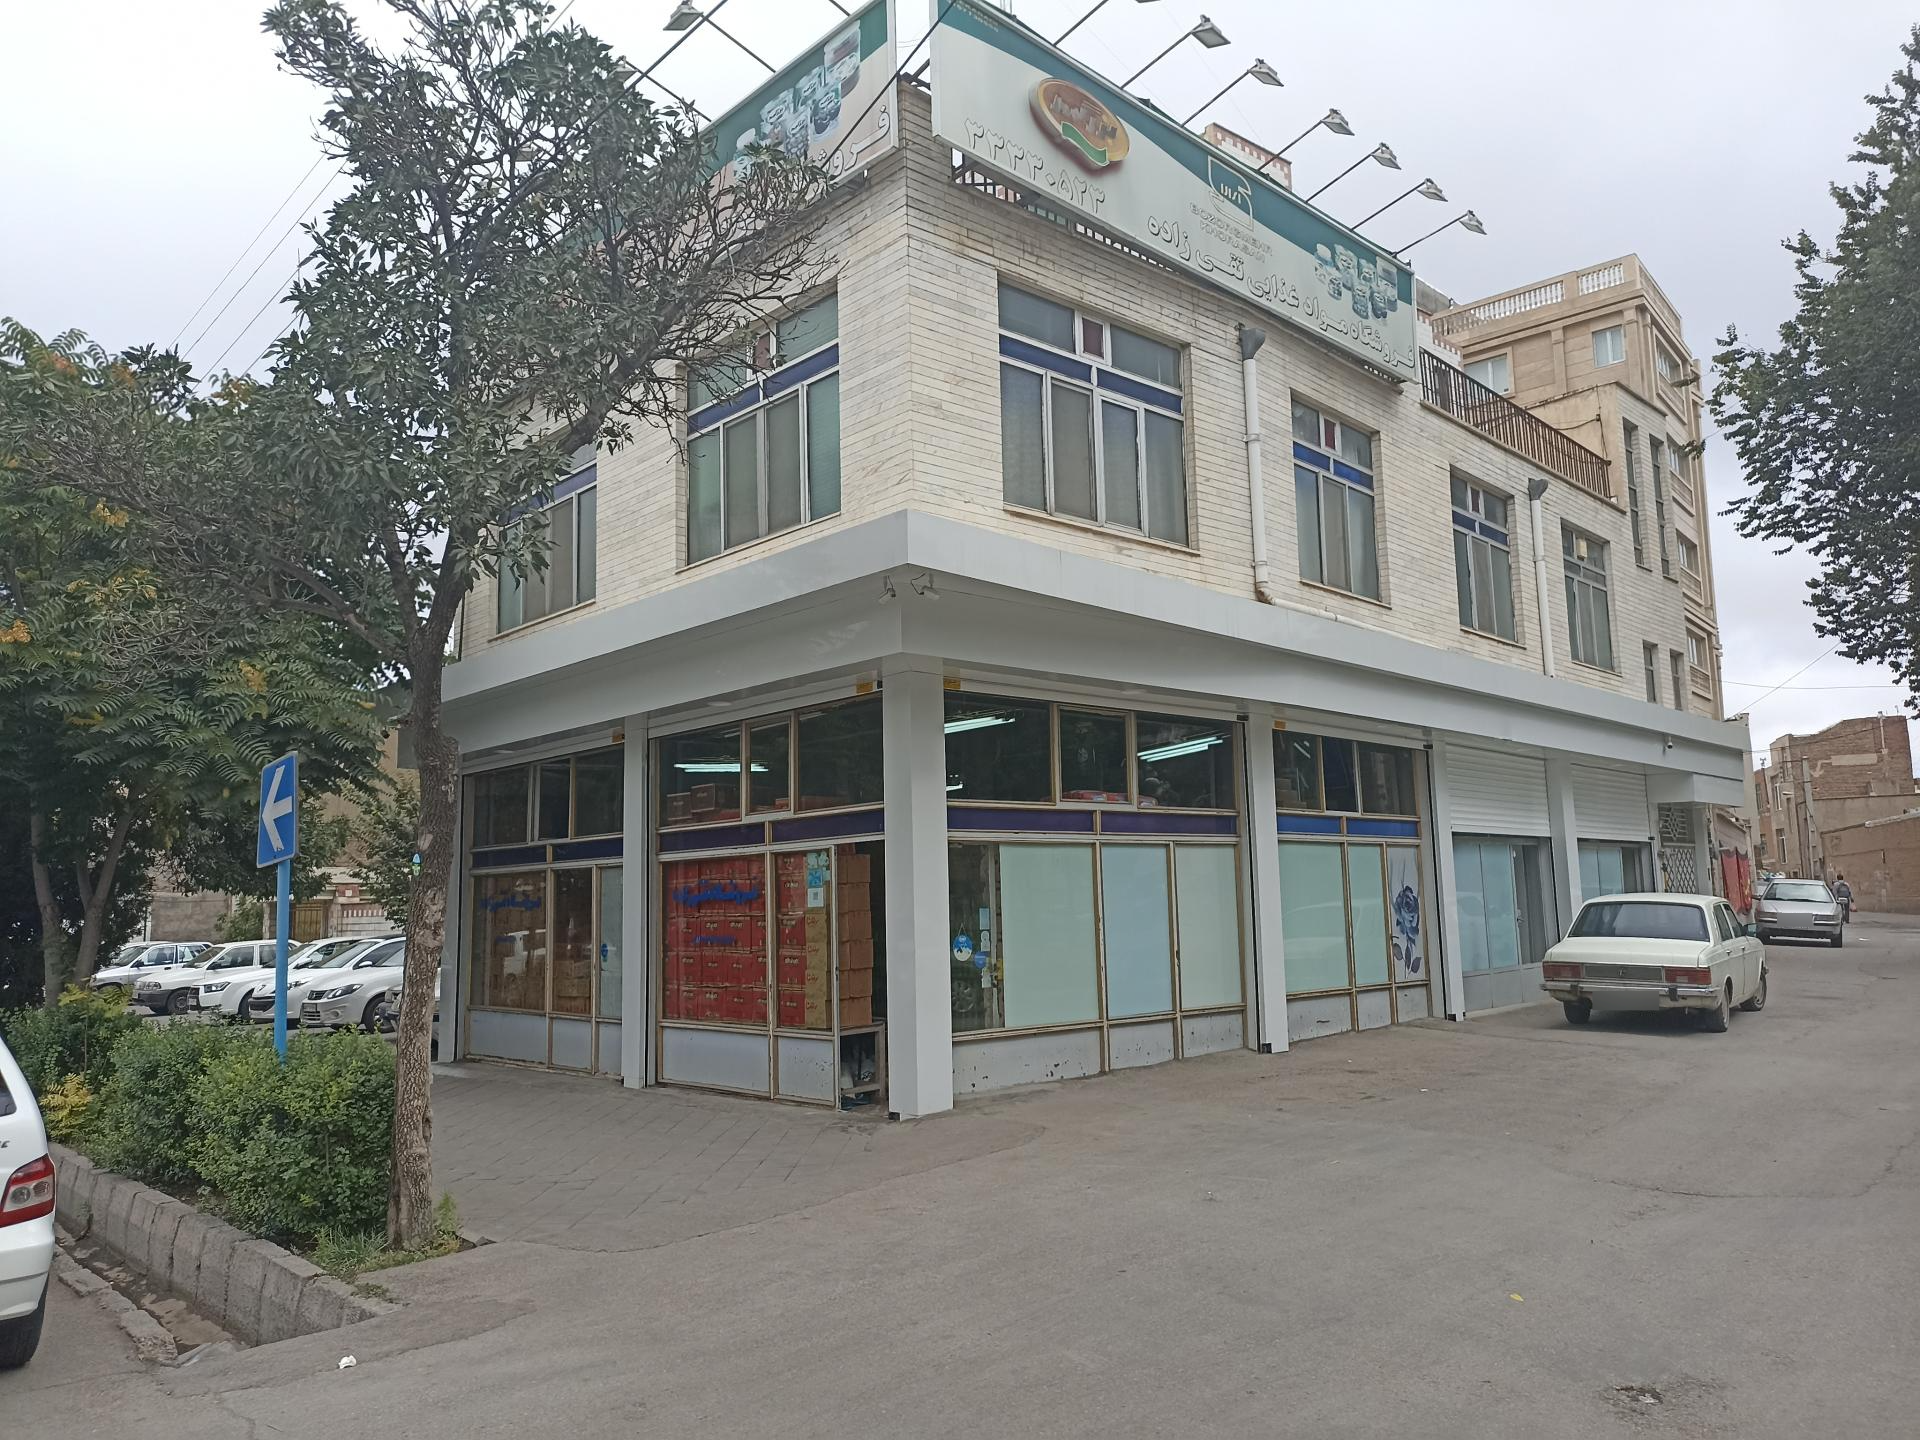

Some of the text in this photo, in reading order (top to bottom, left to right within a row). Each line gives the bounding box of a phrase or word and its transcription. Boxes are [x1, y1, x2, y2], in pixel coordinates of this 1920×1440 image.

[1147, 215, 1191, 262] زاده
[1247, 273, 1300, 308] غذایی
[1302, 296, 1348, 336] مواد
[1350, 321, 1416, 368] فروشگاه
